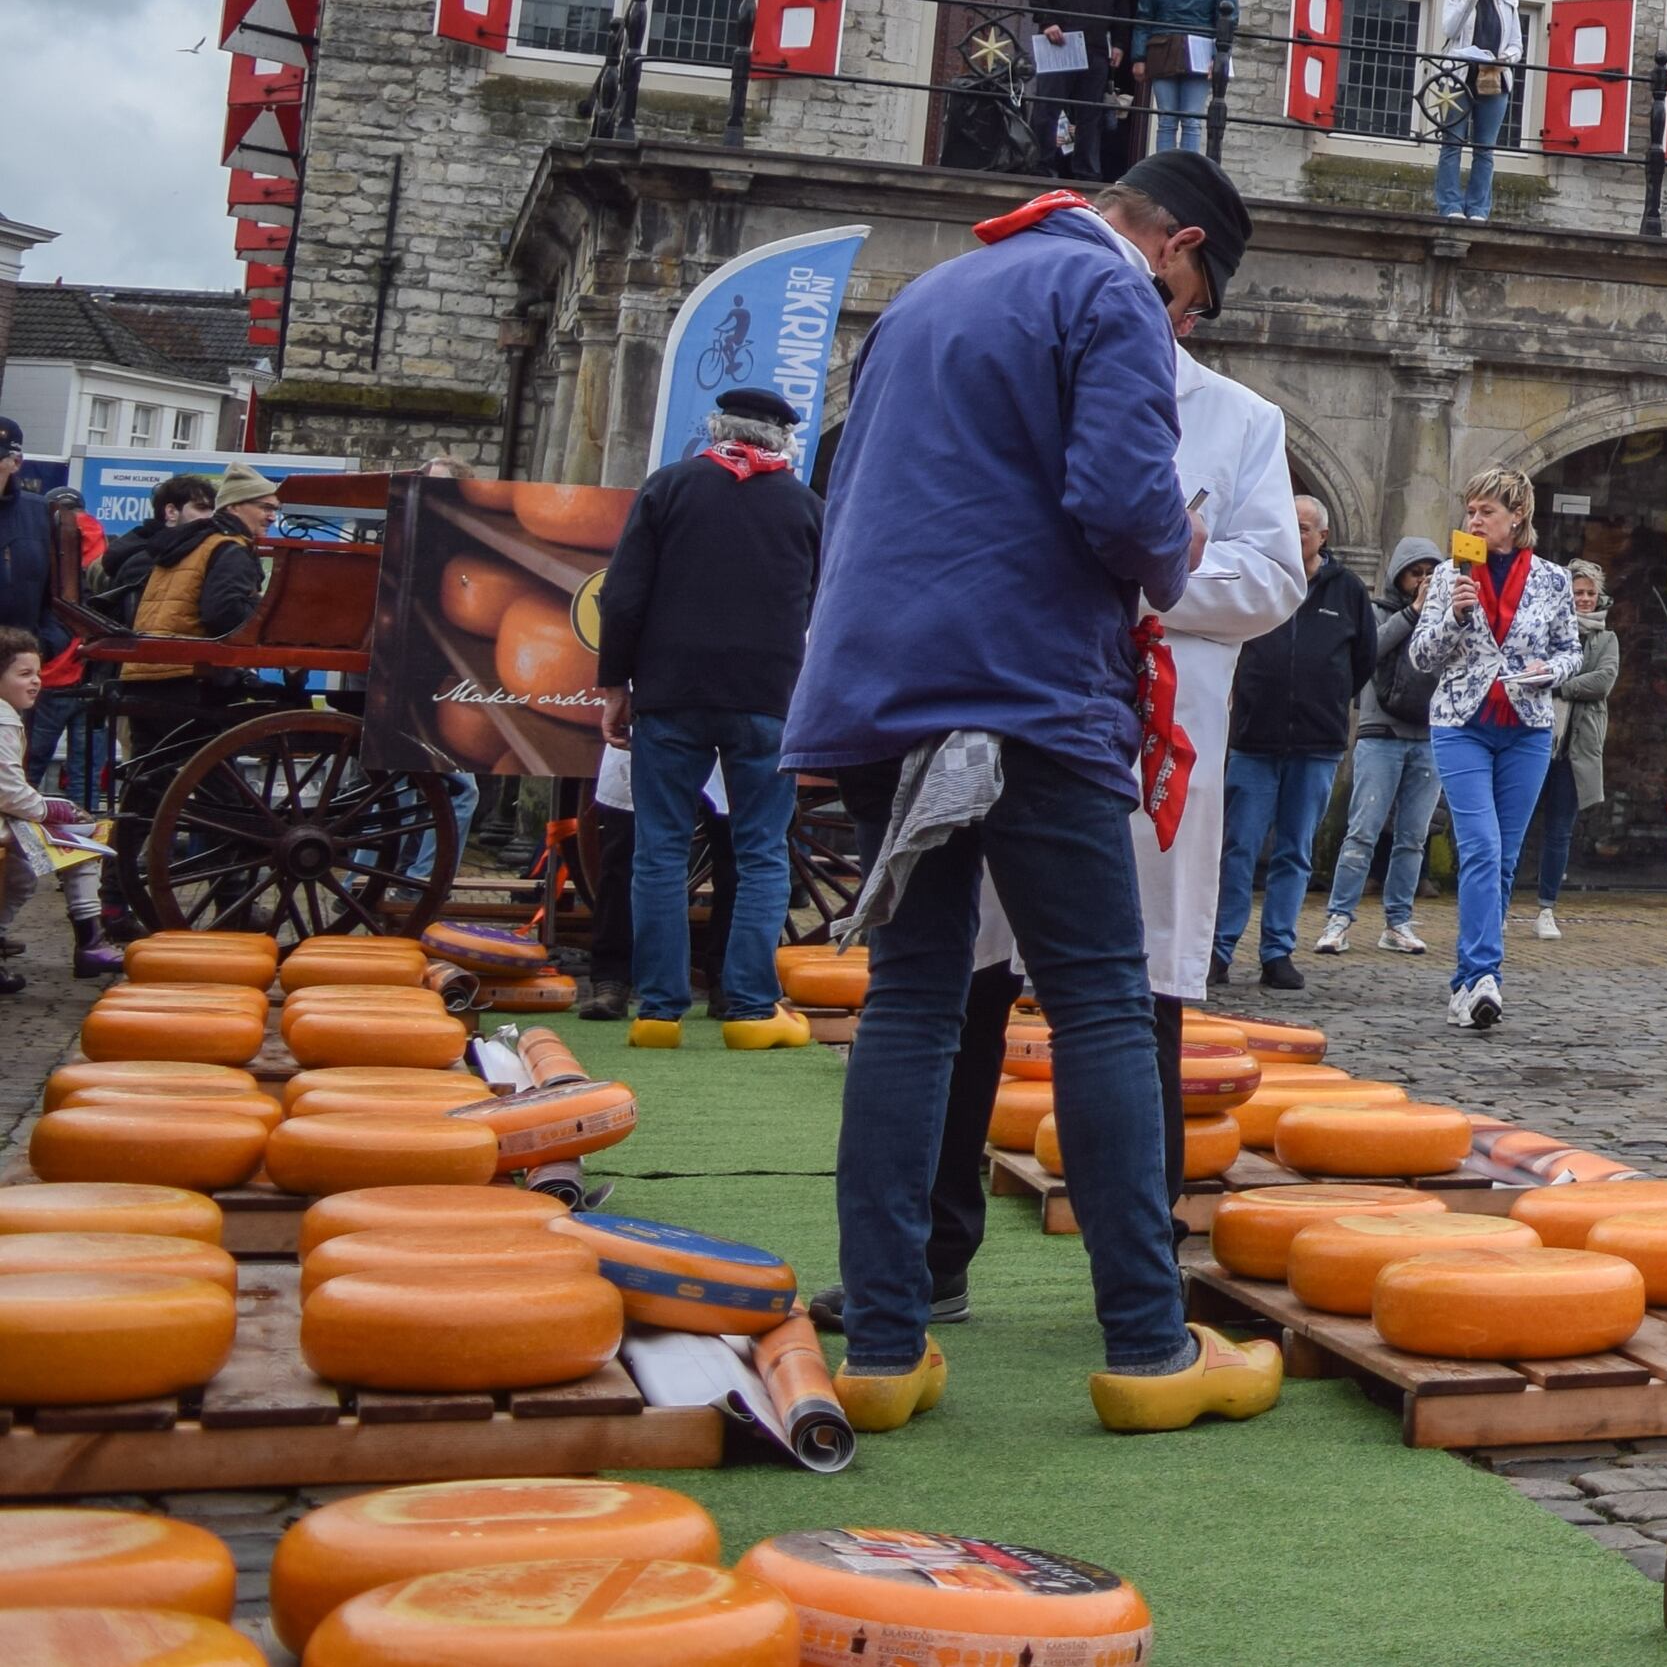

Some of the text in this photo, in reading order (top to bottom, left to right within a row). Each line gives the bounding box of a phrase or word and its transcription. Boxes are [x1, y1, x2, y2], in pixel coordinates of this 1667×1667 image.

[785, 267, 814, 292] DE
[809, 275, 836, 294] IN
[772, 291, 832, 481] KRIMPEN
[102, 496, 113, 508] IN
[96, 507, 112, 521] DE
[432, 679, 609, 707] Makes ordin
